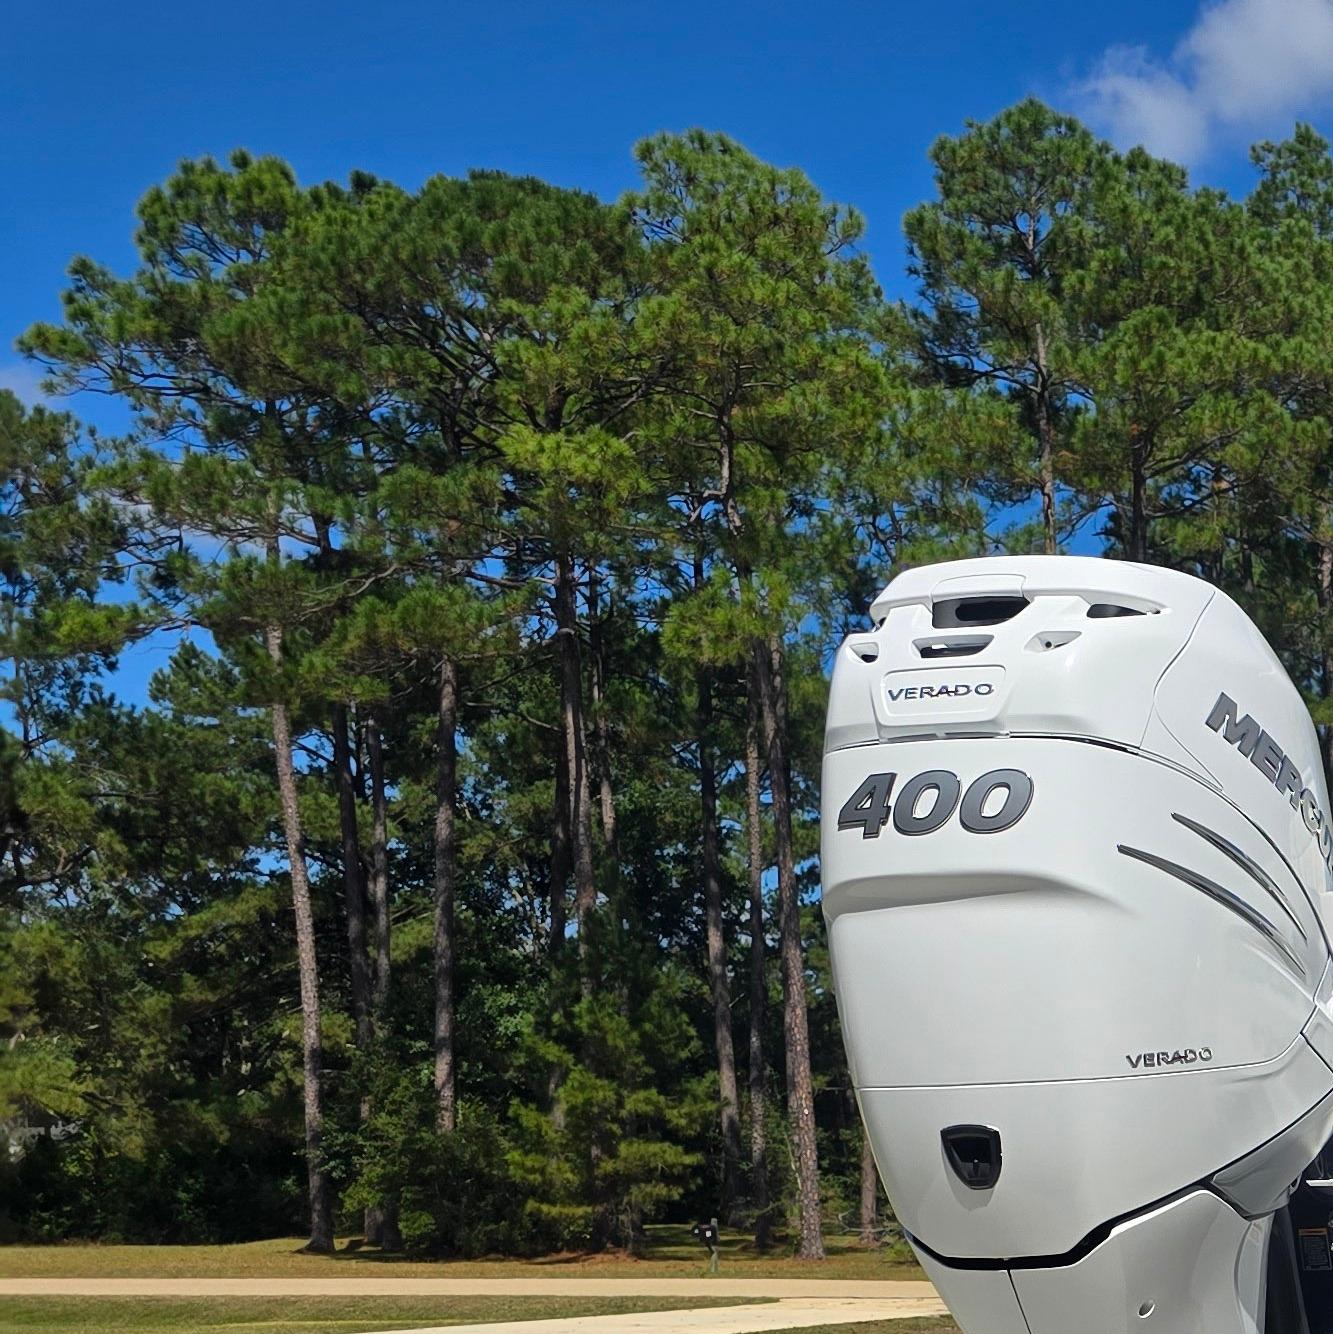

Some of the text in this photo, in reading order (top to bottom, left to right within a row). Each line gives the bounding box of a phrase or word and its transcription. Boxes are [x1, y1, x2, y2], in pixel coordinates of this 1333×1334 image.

[888, 683, 996, 701] VERADO
[837, 768, 1035, 840] 400
[1126, 1046, 1213, 1069] VERADO
